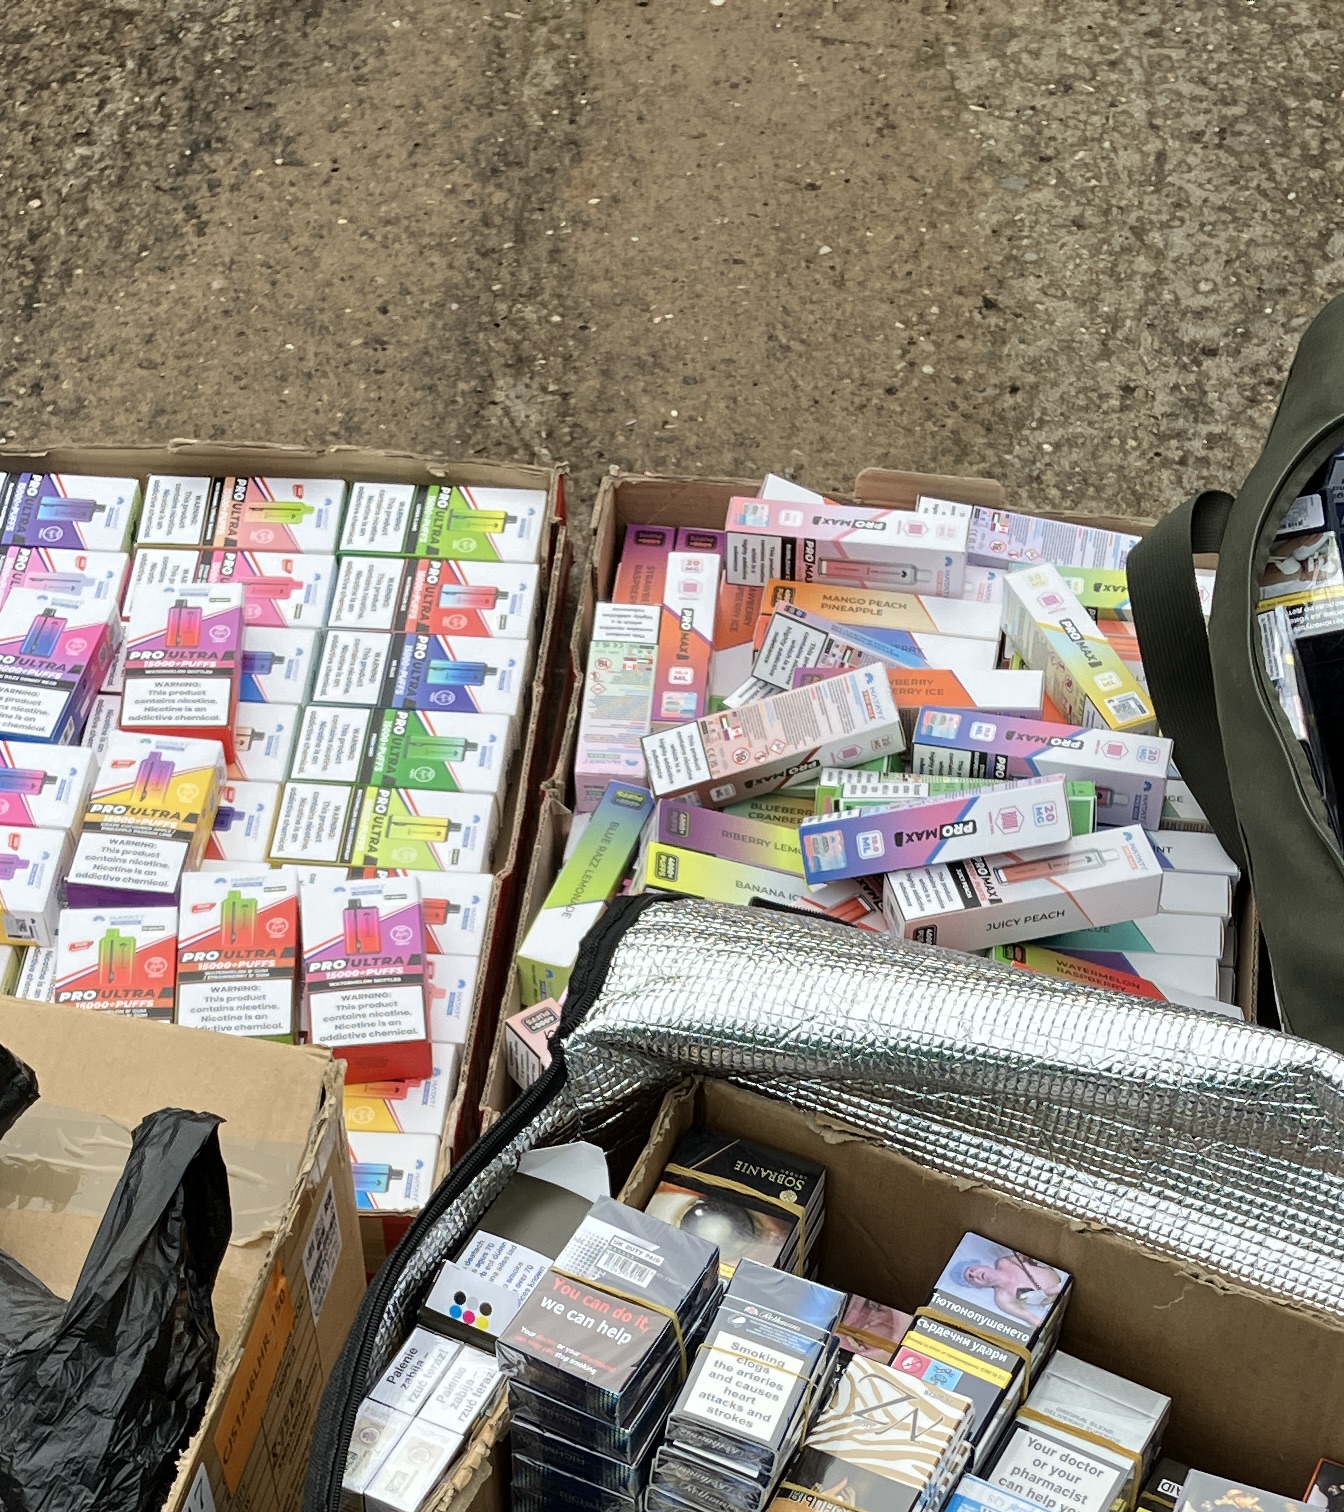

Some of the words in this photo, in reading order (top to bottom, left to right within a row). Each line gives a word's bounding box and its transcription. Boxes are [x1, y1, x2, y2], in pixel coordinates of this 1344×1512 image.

[820, 603, 883, 616] PINEAPPLE
[822, 594, 865, 605] MANGO
[868, 599, 907, 610] PEACH
[17, 657, 67, 671] ULTRA
[130, 651, 165, 660] PRO
[168, 651, 217, 660] ULTRA
[1015, 732, 1047, 742] MAX
[1050, 738, 1084, 749] PRO
[606, 821, 620, 843] BLUE
[721, 830, 771, 847] RIBERRY
[904, 829, 938, 843] MAX
[942, 822, 976, 837] PRO
[590, 845, 608, 868] RAZZ
[561, 870, 593, 919] LEMONADE
[735, 880, 785, 898] BANANA
[986, 919, 1021, 932] JUICY
[1024, 910, 1065, 925] PEACH
[182, 951, 220, 962] PRO
[223, 949, 275, 960] ULTRA
[309, 960, 346, 972] PRO
[350, 957, 404, 968] ULTRA
[1056, 960, 1140, 990] WATERMELON
[341, 992, 391, 1001] WARNING:
[734, 1160, 806, 1191] SOBRANIE
[613, 1239, 624, 1247] UK
[624, 1244, 645, 1257] DUTY
[644, 1252, 662, 1264] PAID
[552, 1277, 581, 1300] You
[583, 1295, 610, 1314] can
[612, 1307, 632, 1323] do
[634, 1314, 650, 1334] it,
[931, 1292, 1030, 1342] Тютюнопушенето
[540, 1296, 565, 1315] we
[567, 1309, 594, 1329] can
[596, 1320, 632, 1346] help
[916, 1318, 971, 1348] сърдечни
[970, 1341, 1008, 1363] удари
[386, 1346, 418, 1385] Palenie
[730, 1341, 785, 1368] Smoking
[736, 1357, 770, 1374] clogs
[401, 1359, 424, 1390] zabija
[407, 1380, 428, 1404] rzuć
[422, 1348, 446, 1380] teraz!
[435, 1366, 466, 1405] Palenie
[708, 1370, 733, 1384] and
[735, 1379, 780, 1402] causes
[714, 1359, 733, 1372] the
[736, 1365, 784, 1392] arteries
[451, 1378, 473, 1411] zabija
[458, 1399, 478, 1422] rzuć
[472, 1368, 497, 1399] teraz!
[698, 1390, 744, 1413] attacks
[746, 1405, 772, 1423] and
[723, 1386, 757, 1405] heart
[706, 1405, 754, 1429] strokes
[1027, 1437, 1057, 1457] Your
[1058, 1452, 1105, 1478] doctor
[1032, 1457, 1047, 1469] or
[1049, 1465, 1082, 1485] your
[999, 1477, 1023, 1494] can
[1026, 1487, 1056, 1508] help
[1010, 1464, 1088, 1506] pharmacist
